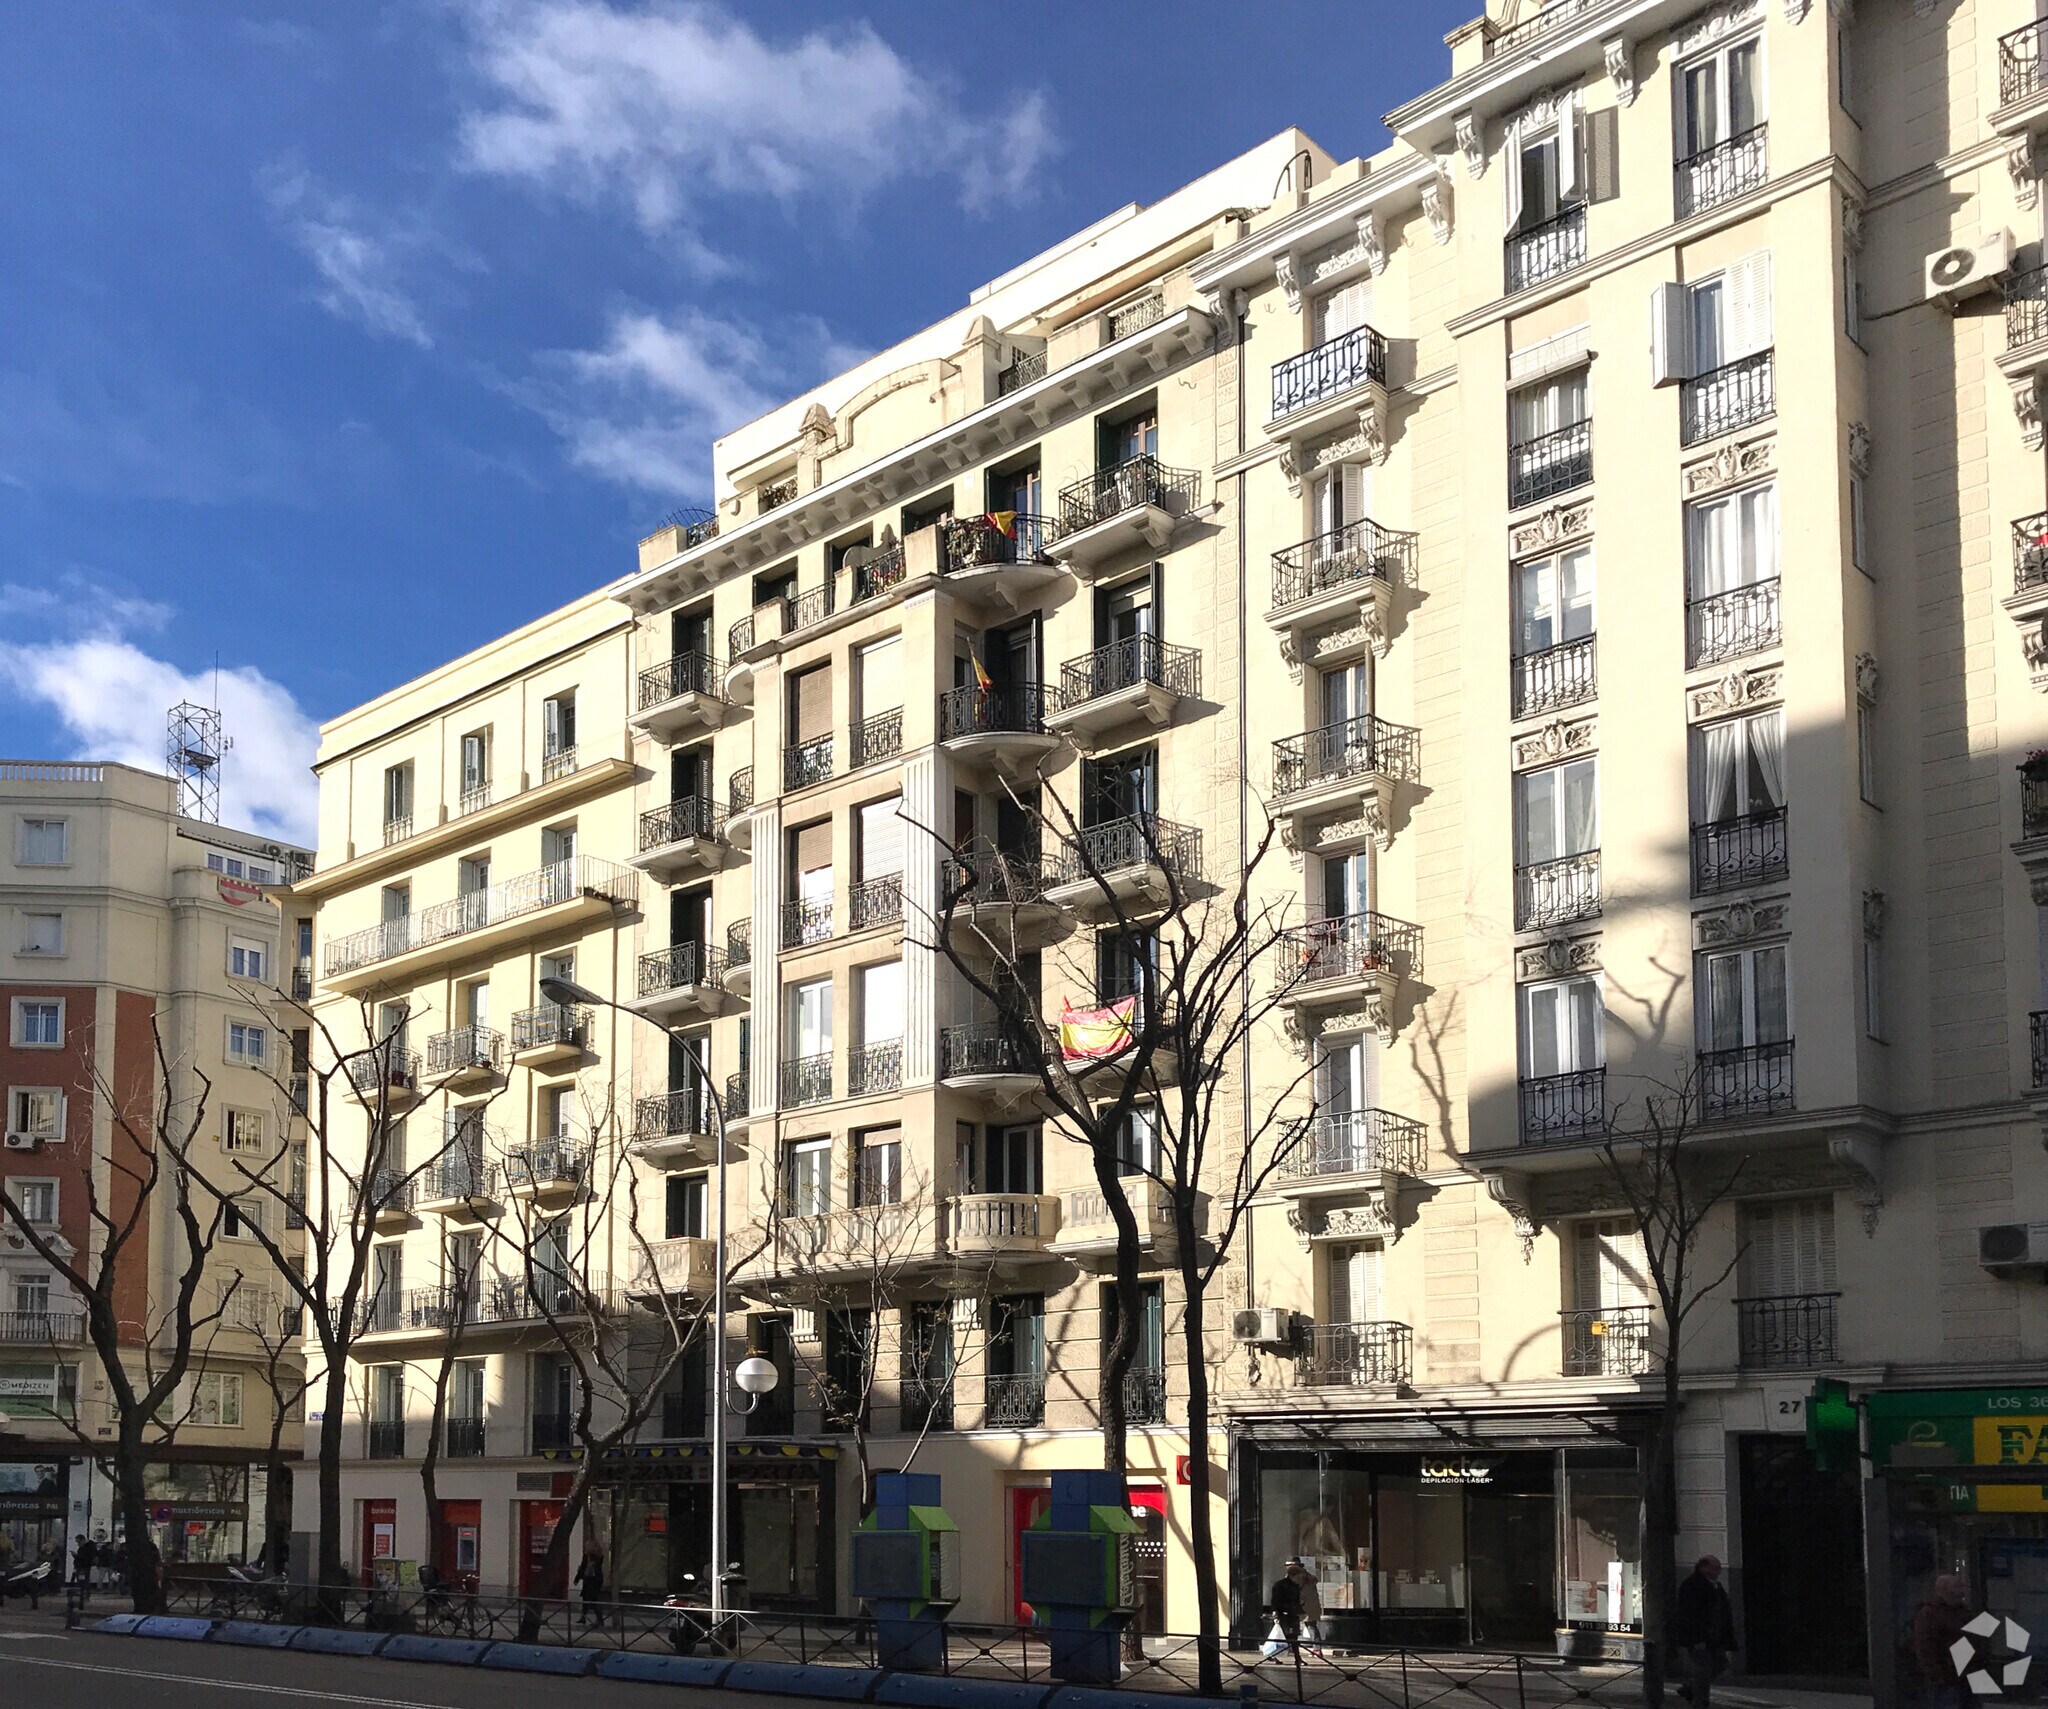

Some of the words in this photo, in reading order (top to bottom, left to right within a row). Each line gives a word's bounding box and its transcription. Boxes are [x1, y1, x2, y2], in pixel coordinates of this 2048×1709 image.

[1779, 1400, 1801, 1414] 27
[1988, 1397, 2022, 1409] LOS
[1608, 1623, 1619, 1632] 93
[1620, 1624, 1631, 1633] 54
